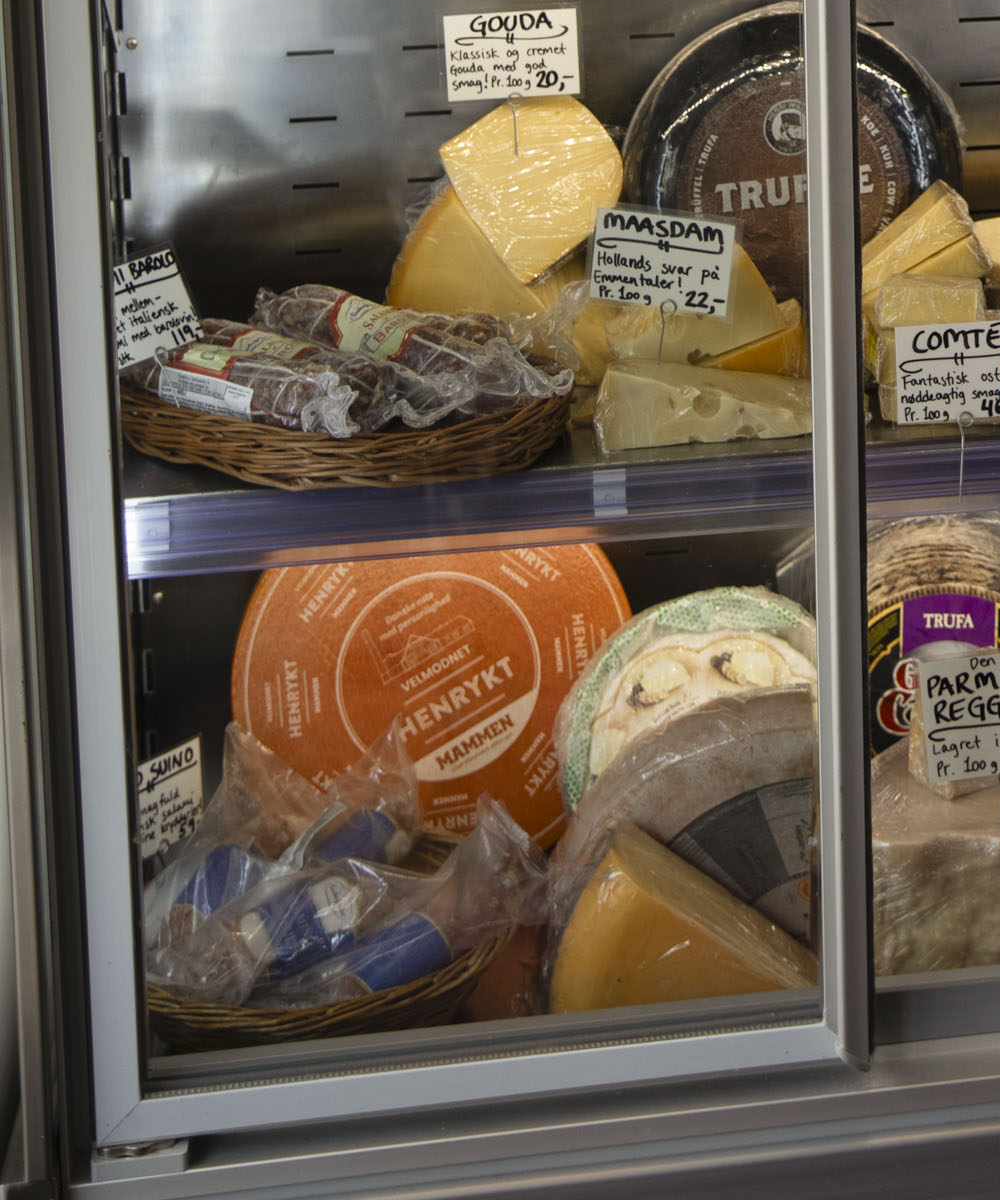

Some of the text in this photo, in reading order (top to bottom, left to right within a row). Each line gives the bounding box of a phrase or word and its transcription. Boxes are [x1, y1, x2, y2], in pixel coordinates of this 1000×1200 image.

[470, 12, 553, 36] GOUDA
[450, 42, 567, 61] Klassisk cremet
[450, 63, 485, 76] Gouda
[452, 70, 574, 94] smag! 20,-
[861, 115, 880, 136] KOE
[698, 134, 719, 166] TRUFA
[880, 144, 894, 169] KUH
[887, 181, 896, 206] COW
[604, 213, 723, 245] MAASDAM
[129, 251, 176, 280] BAROLO
[598, 251, 651, 272] Hollands
[594, 271, 682, 294] Emmentaler!
[129, 301, 179, 326] italiensk
[685, 290, 725, 314] 22,-
[171, 325, 203, 346] 119,-
[912, 322, 1000, 353] COMTÉ
[901, 371, 969, 390] Fantastisk
[901, 387, 965, 404] nøddeagtig
[923, 612, 974, 629] TRUFA
[400, 643, 472, 692] VELMODNET
[970, 657, 996, 670] Den
[284, 660, 302, 738] HENRYKT
[399, 656, 513, 742] HENRYKT
[435, 714, 515, 770] MAMMEN
[932, 736, 981, 758] Lagret
[150, 747, 194, 781] SUINO
